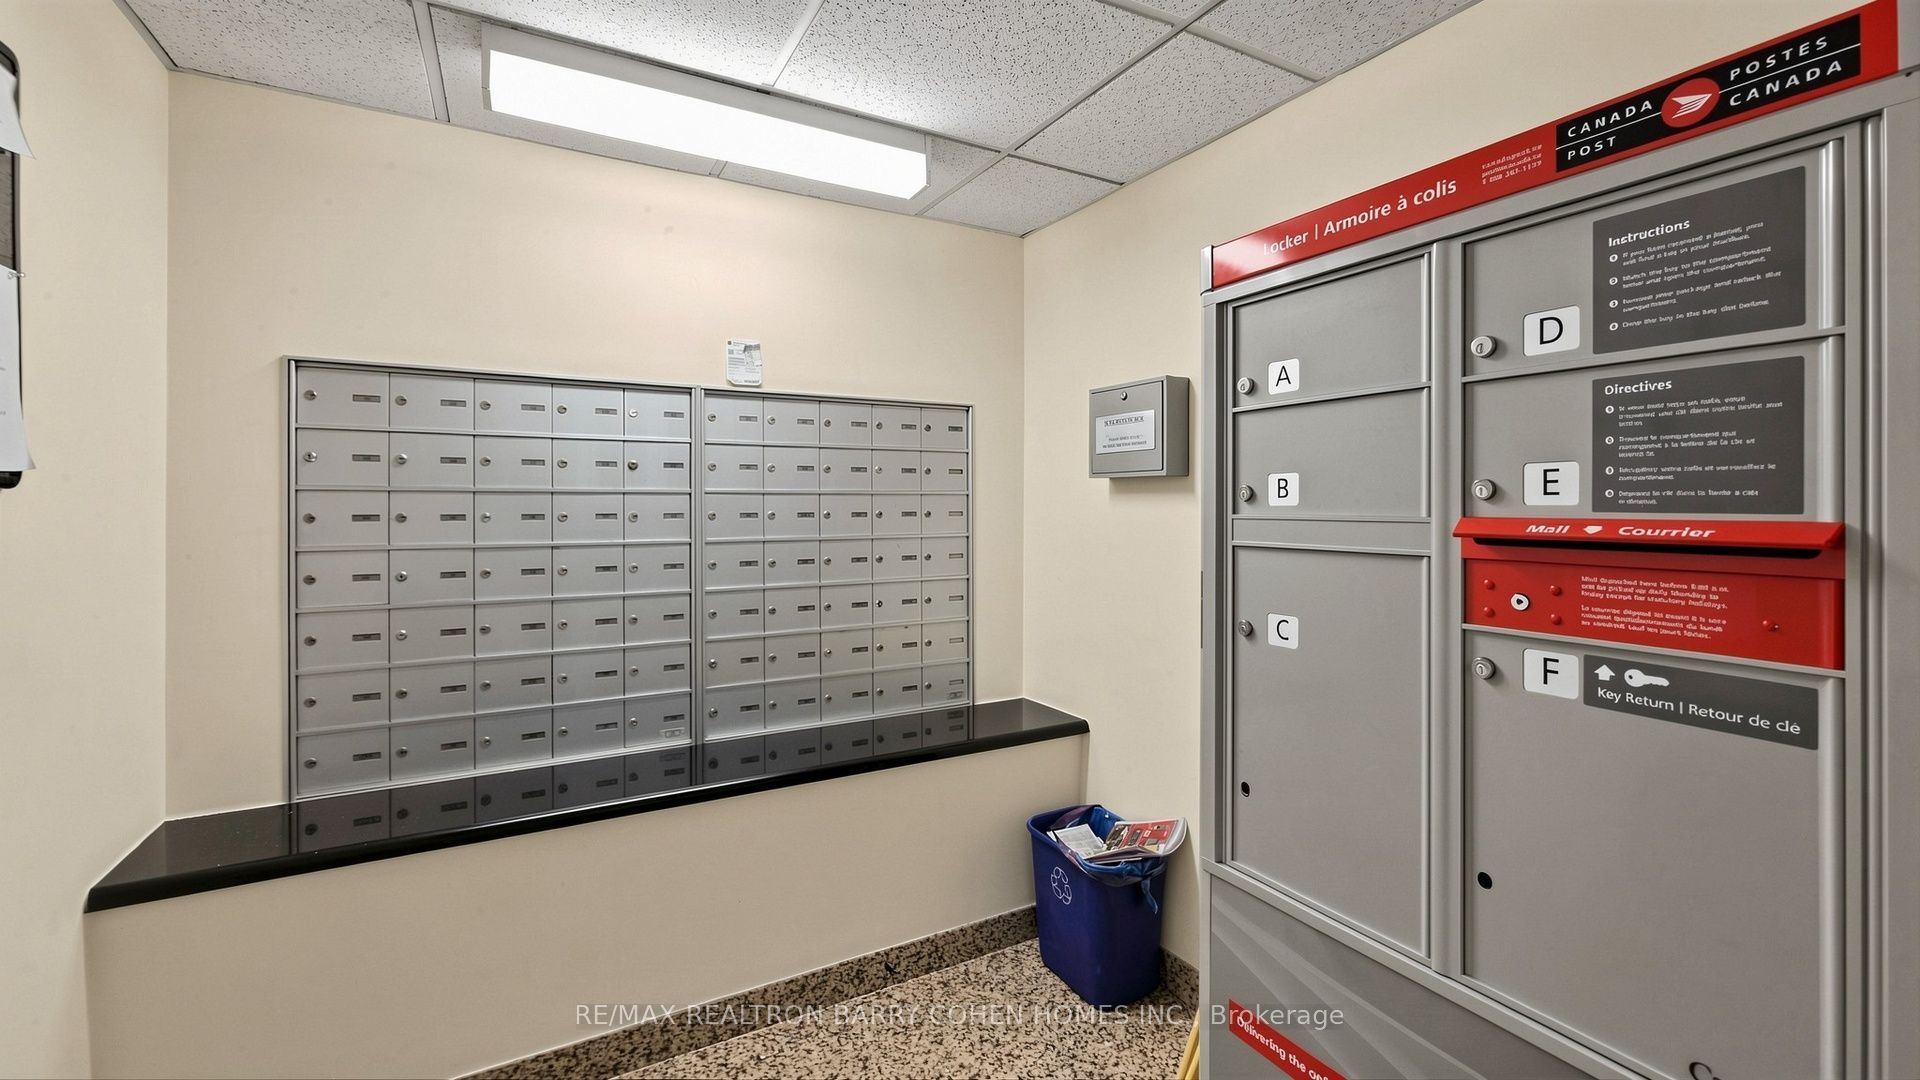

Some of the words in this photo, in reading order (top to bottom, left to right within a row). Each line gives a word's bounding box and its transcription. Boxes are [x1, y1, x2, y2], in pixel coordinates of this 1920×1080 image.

[1729, 36, 1829, 81] POSTES
[1729, 60, 1843, 107] CANADA
[1567, 100, 1653, 138] CANADA
[1567, 136, 1617, 161] POST
[1323, 203, 1392, 237] Armoire
[1397, 194, 1408, 211] à
[1413, 178, 1457, 206] colis
[1608, 219, 1691, 247] Instructions
[1539, 316, 1564, 345] D
[1275, 365, 1292, 388] A
[1604, 380, 1673, 396] Directives
[1277, 478, 1289, 499] B
[1542, 468, 1560, 496] E
[1276, 619, 1290, 641] C
[1543, 657, 1560, 686] F
[1598, 687, 1622, 704] Key
[1626, 692, 1674, 711] Return
[1688, 703, 1744, 723] Retour
[1749, 714, 1771, 730] de
[1776, 719, 1801, 735] clé
[1288, 1053, 1307, 1073] the
